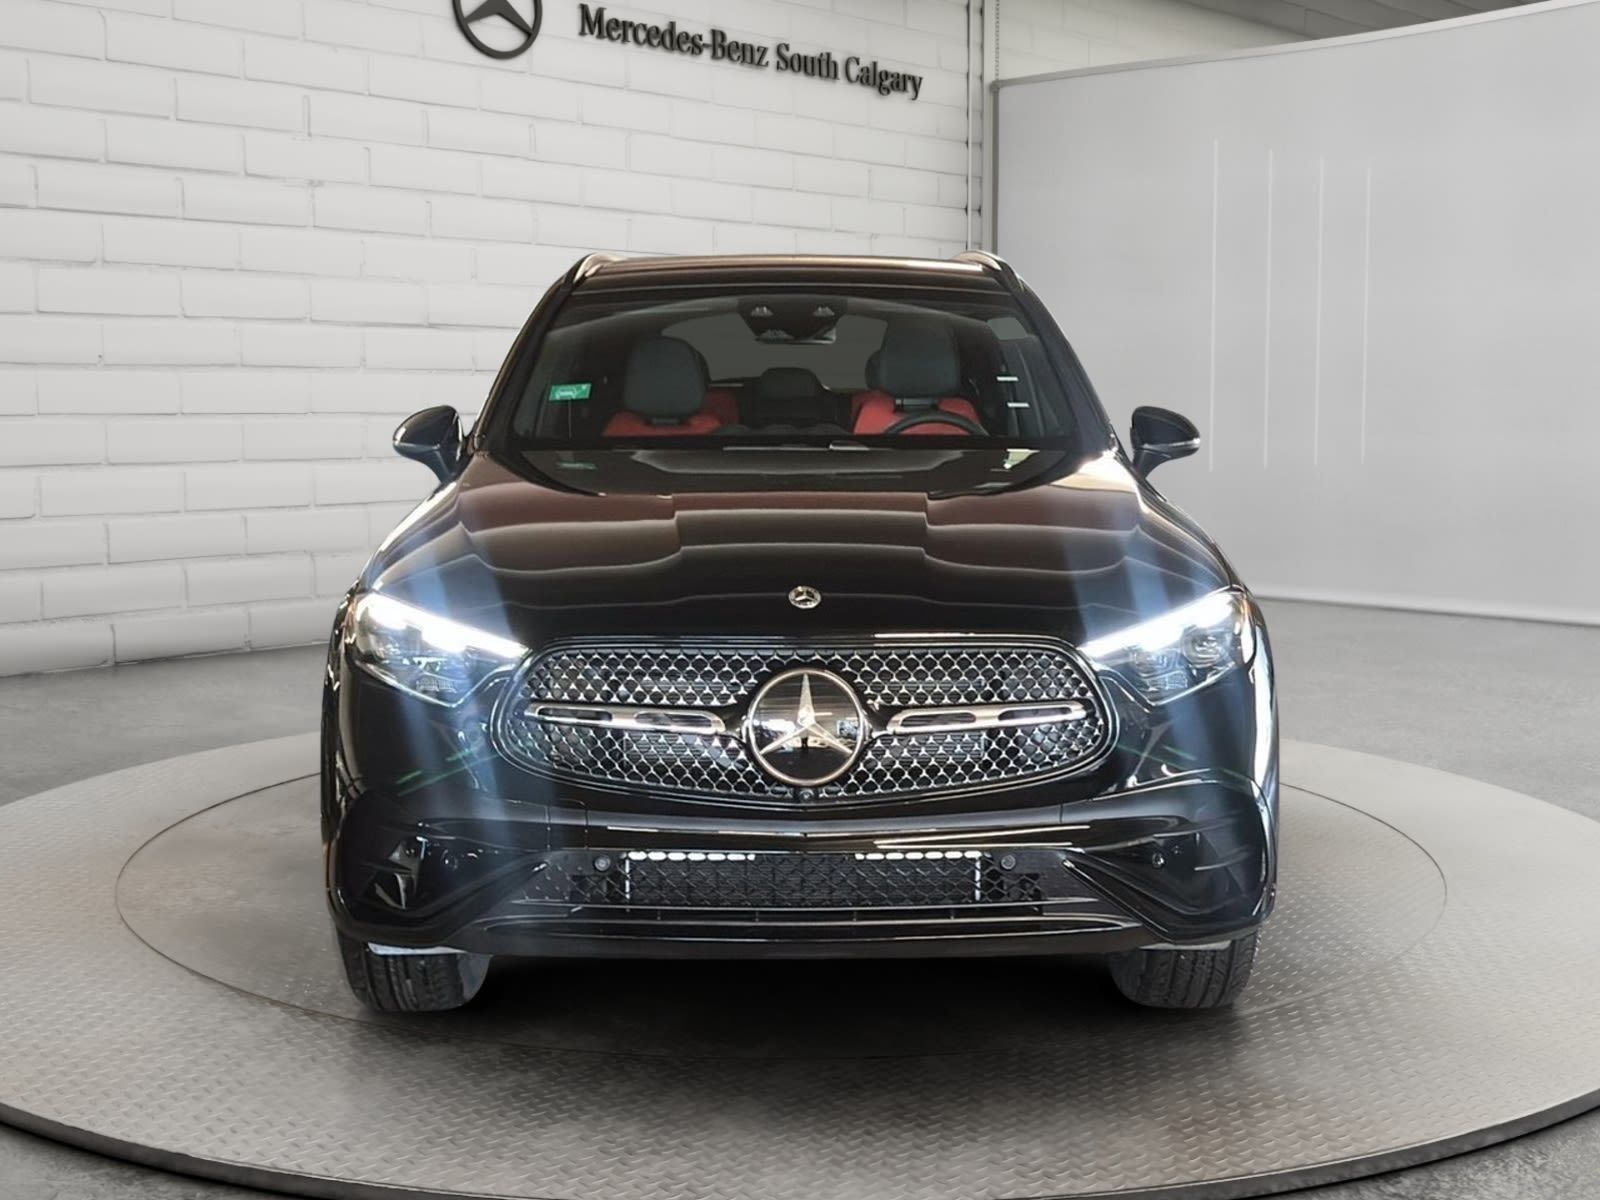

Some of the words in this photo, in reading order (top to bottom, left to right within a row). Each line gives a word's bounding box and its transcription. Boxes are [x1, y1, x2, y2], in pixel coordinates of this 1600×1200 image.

[578, 3, 769, 67] Mercedes-Benz
[775, 42, 840, 81] South
[844, 56, 923, 100] Calgary
